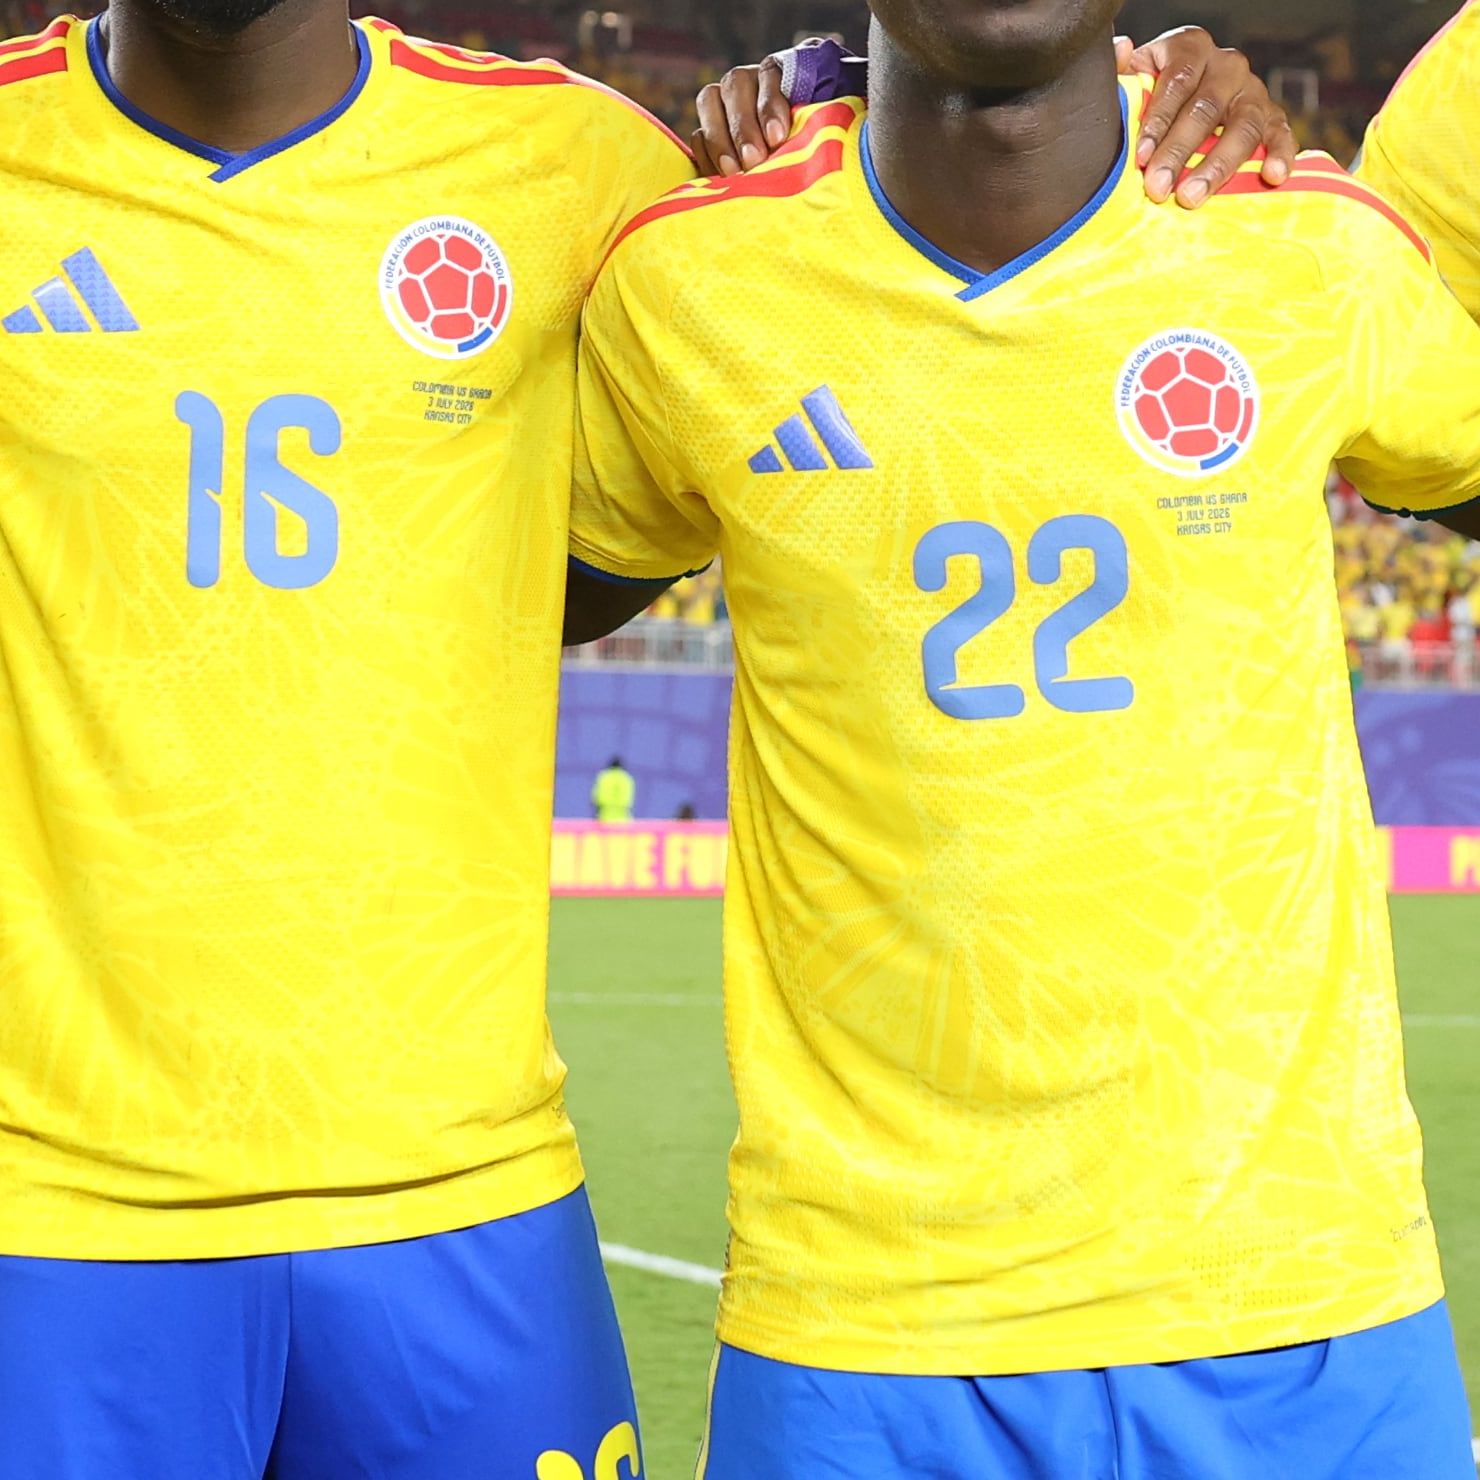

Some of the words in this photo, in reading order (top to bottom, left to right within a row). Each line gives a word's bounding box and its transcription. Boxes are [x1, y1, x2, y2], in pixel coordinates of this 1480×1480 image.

[412, 220, 474, 238] COLOMBIANA
[473, 233, 487, 247] DE
[1149, 333, 1217, 352] COLOMBIANA
[1216, 344, 1230, 359] DE
[423, 409, 455, 423] KANSAS
[456, 413, 472, 425] CITY
[174, 389, 342, 591] 16
[1156, 495, 1203, 510] COLOMBIA
[1220, 492, 1248, 505] GHANA
[1186, 509, 1204, 521] JULY
[1208, 507, 1231, 520] 2026
[1176, 523, 1211, 536] KANSAS
[1214, 521, 1232, 534] CITY
[912, 513, 1135, 721] 22
[664, 833, 728, 889] FU
